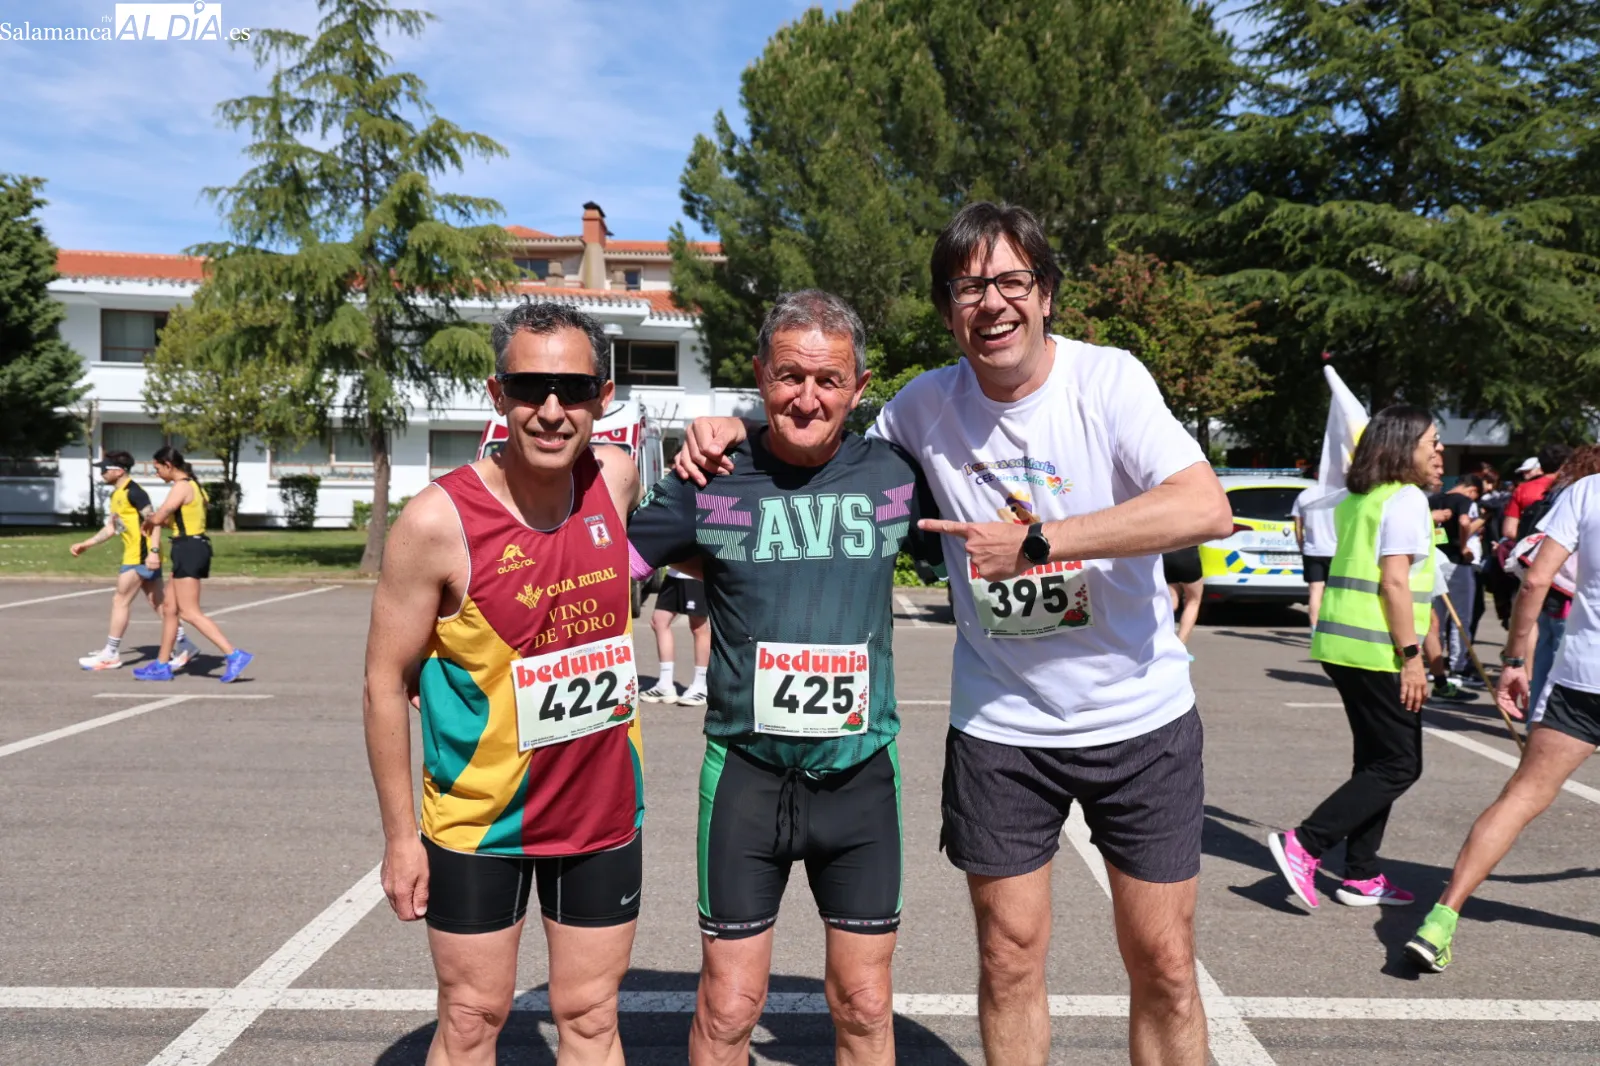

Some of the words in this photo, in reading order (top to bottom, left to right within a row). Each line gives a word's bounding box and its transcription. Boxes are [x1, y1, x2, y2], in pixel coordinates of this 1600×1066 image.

[752, 493, 876, 562] AVS
[577, 567, 617, 588] RURAL
[988, 575, 1069, 618] 395
[534, 627, 559, 649] DE
[561, 612, 616, 640] TORO
[548, 597, 598, 624] VINO
[516, 643, 632, 689] bedunia
[758, 647, 868, 673] bedunia
[538, 670, 620, 722] 422
[772, 674, 855, 715] 425
